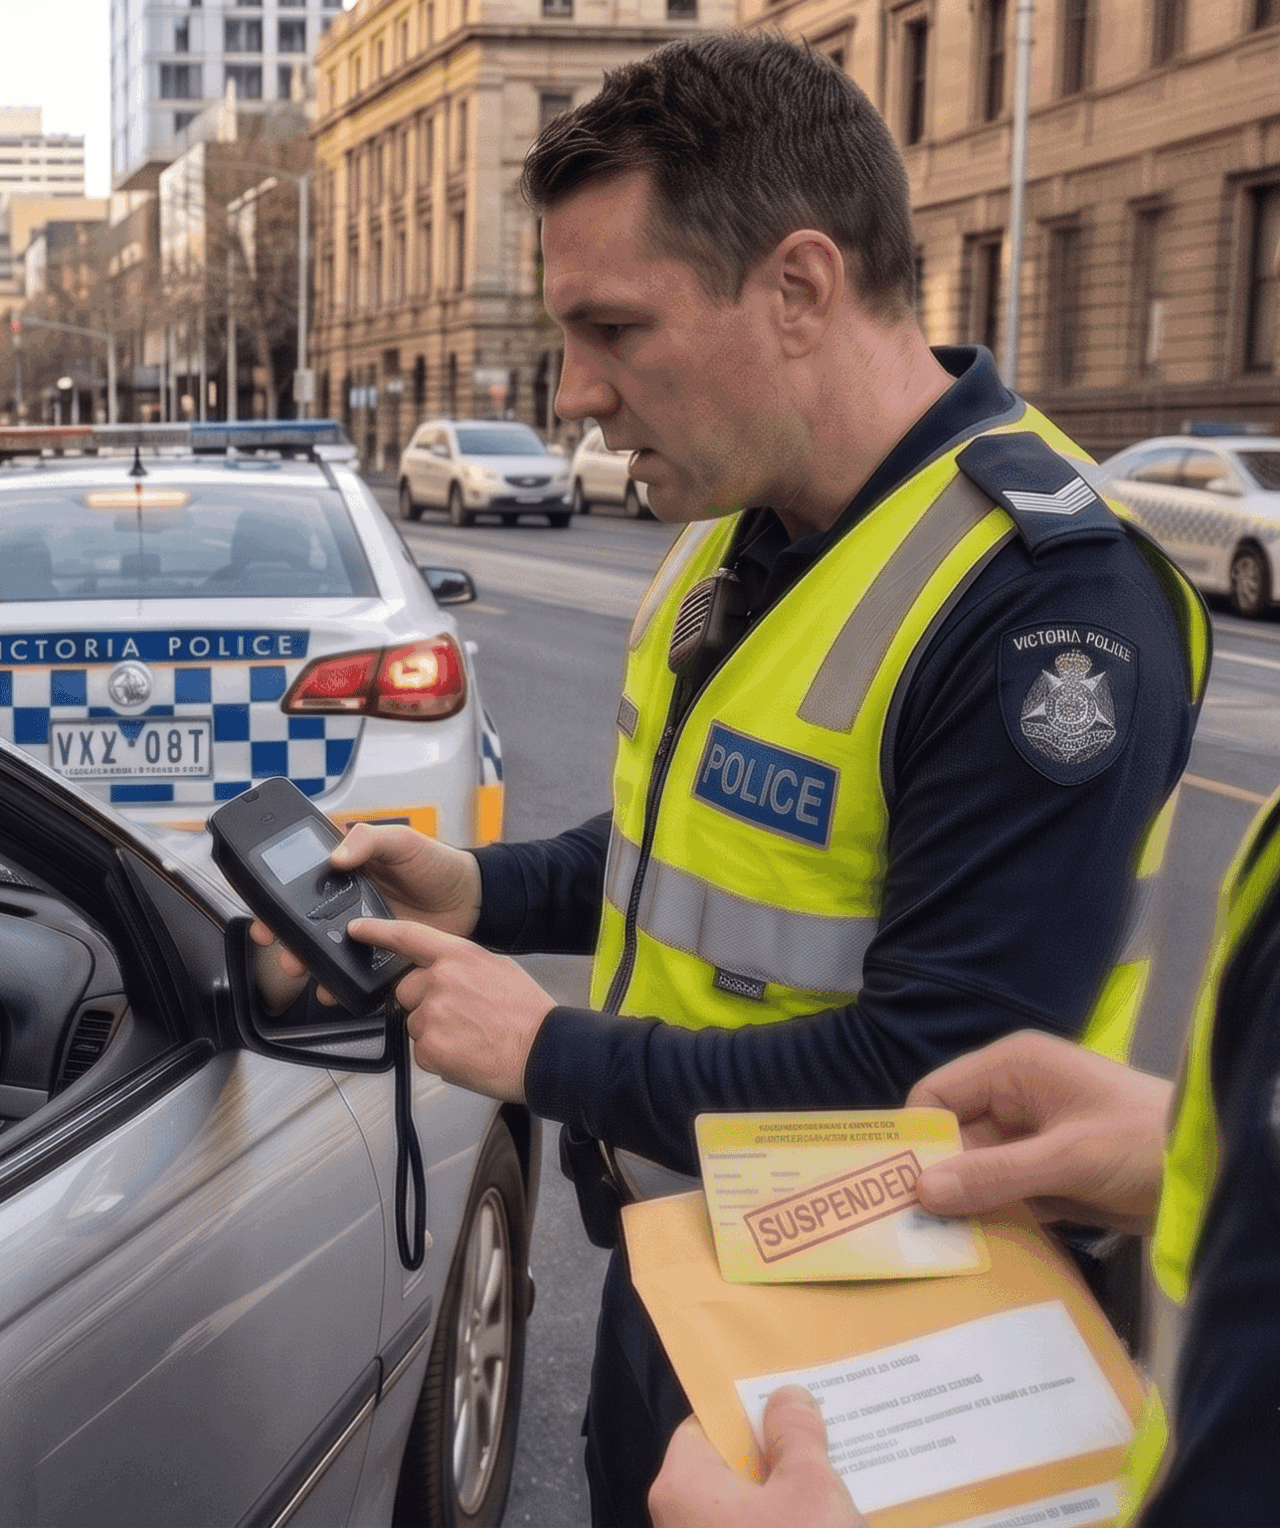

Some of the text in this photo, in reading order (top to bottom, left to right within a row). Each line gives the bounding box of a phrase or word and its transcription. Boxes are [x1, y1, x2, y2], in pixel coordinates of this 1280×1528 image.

[169, 634, 293, 657] POLICE
[1013, 629, 1081, 650] VICTORIA
[145, 729, 204, 764] 08T
[702, 742, 826, 826] POLICE
[758, 1162, 920, 1247] SUSPENDED
